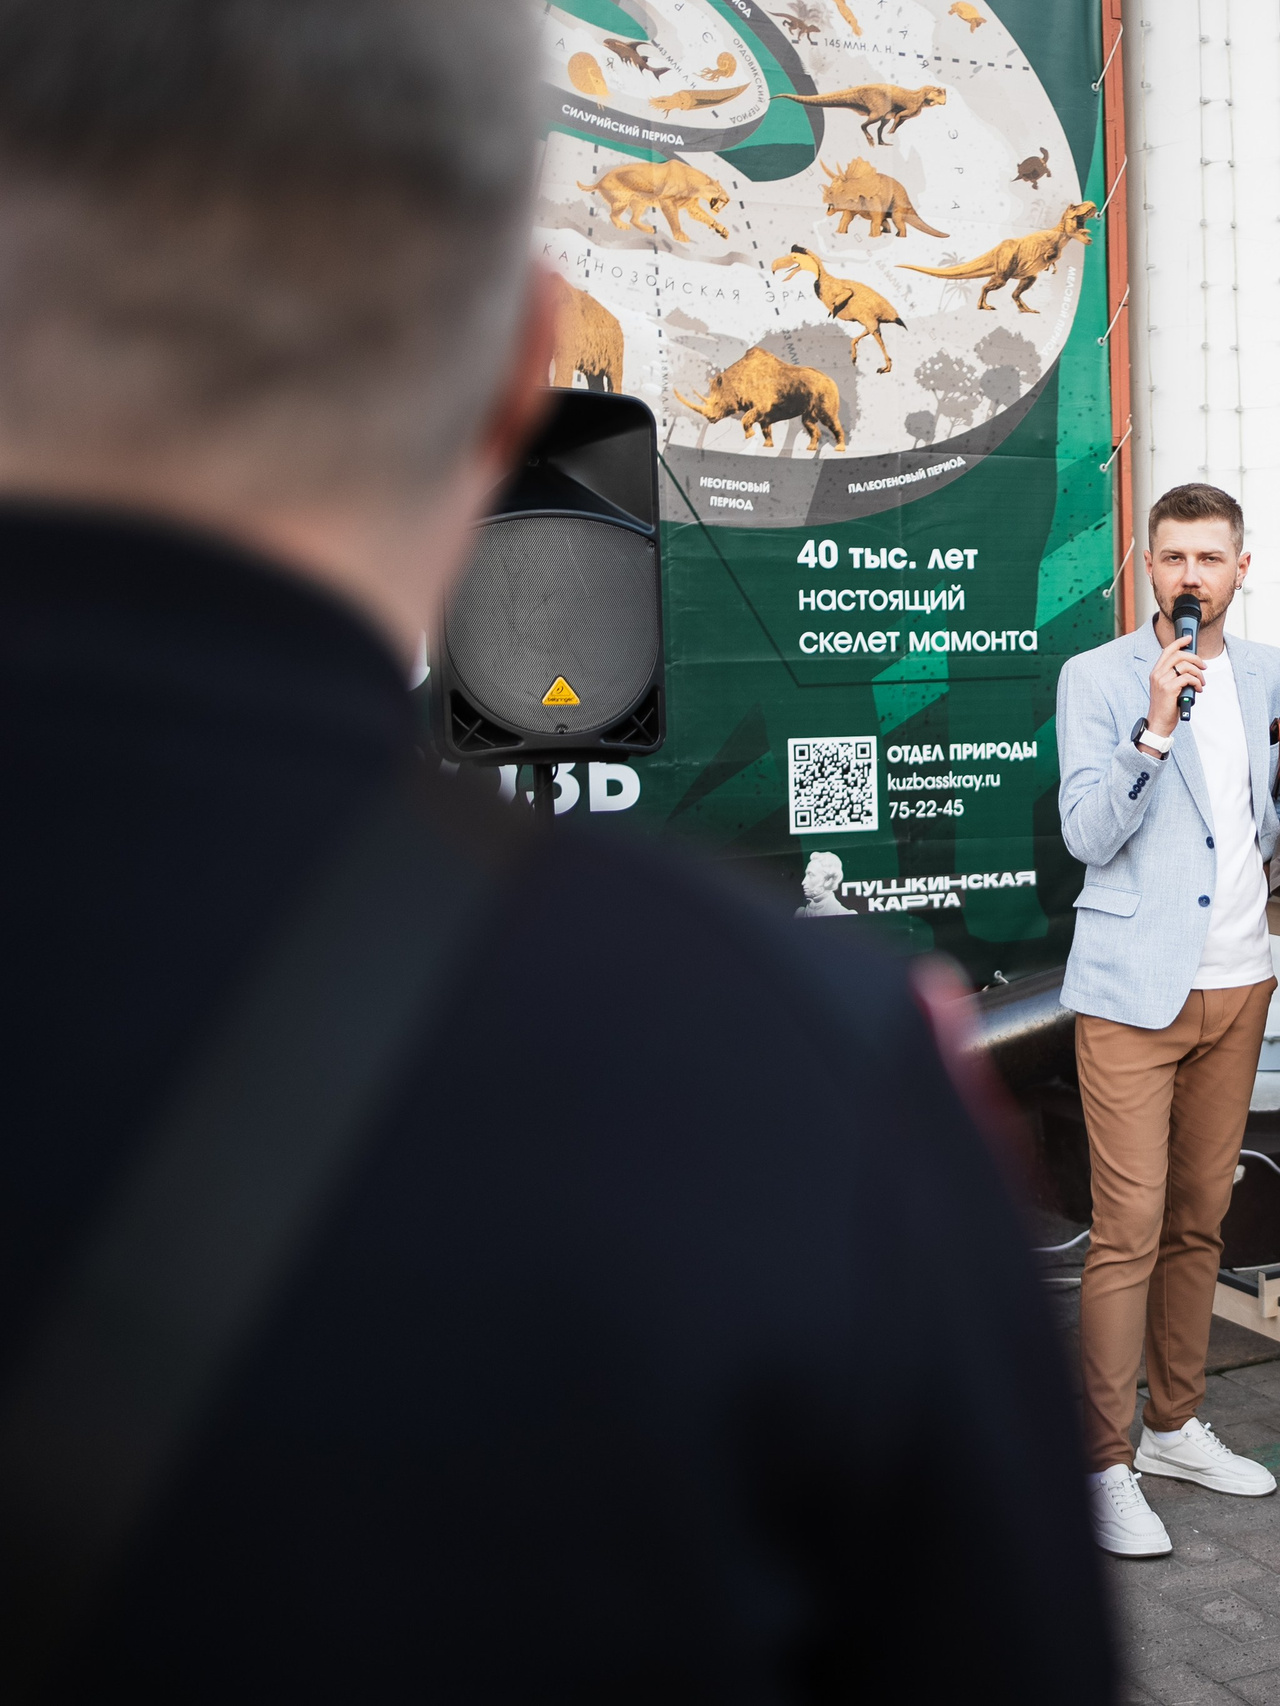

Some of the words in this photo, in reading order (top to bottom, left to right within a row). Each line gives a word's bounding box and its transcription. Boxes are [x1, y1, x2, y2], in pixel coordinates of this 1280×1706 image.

[824, 38, 841, 49] 145
[732, 38, 766, 103] ОРДОВИКСКИЙ
[561, 104, 640, 138] СИЛУРИЙСКИЙ
[641, 130, 685, 146] ПЕРИОД
[729, 104, 761, 125] ПЕРИОД
[542, 242, 741, 302] КАЙНОЗОЙСКАЯ
[765, 290, 807, 304] ЭРА
[699, 475, 770, 494] НЕОГЕНОВЫЙ
[847, 467, 926, 494] ПАЛЕОГЕНОВЫЙ
[926, 455, 967, 478] ПЕРИОД
[709, 495, 754, 512] ПЕРИОД
[797, 538, 839, 569] 40
[848, 547, 917, 570] тыс.
[927, 547, 979, 570] лет
[798, 584, 966, 614] настоящий
[799, 630, 900, 654] скелет
[909, 629, 1038, 653] мамонта
[886, 744, 945, 765] ОТДЕЛ
[948, 741, 1038, 761] ПРИРОДЫ
[887, 771, 1001, 793] kuzbasskray.ru
[888, 799, 964, 820] 75-22-45
[841, 870, 1037, 897] ПУШКИНСКАЯ
[867, 891, 961, 913] КАРТА
